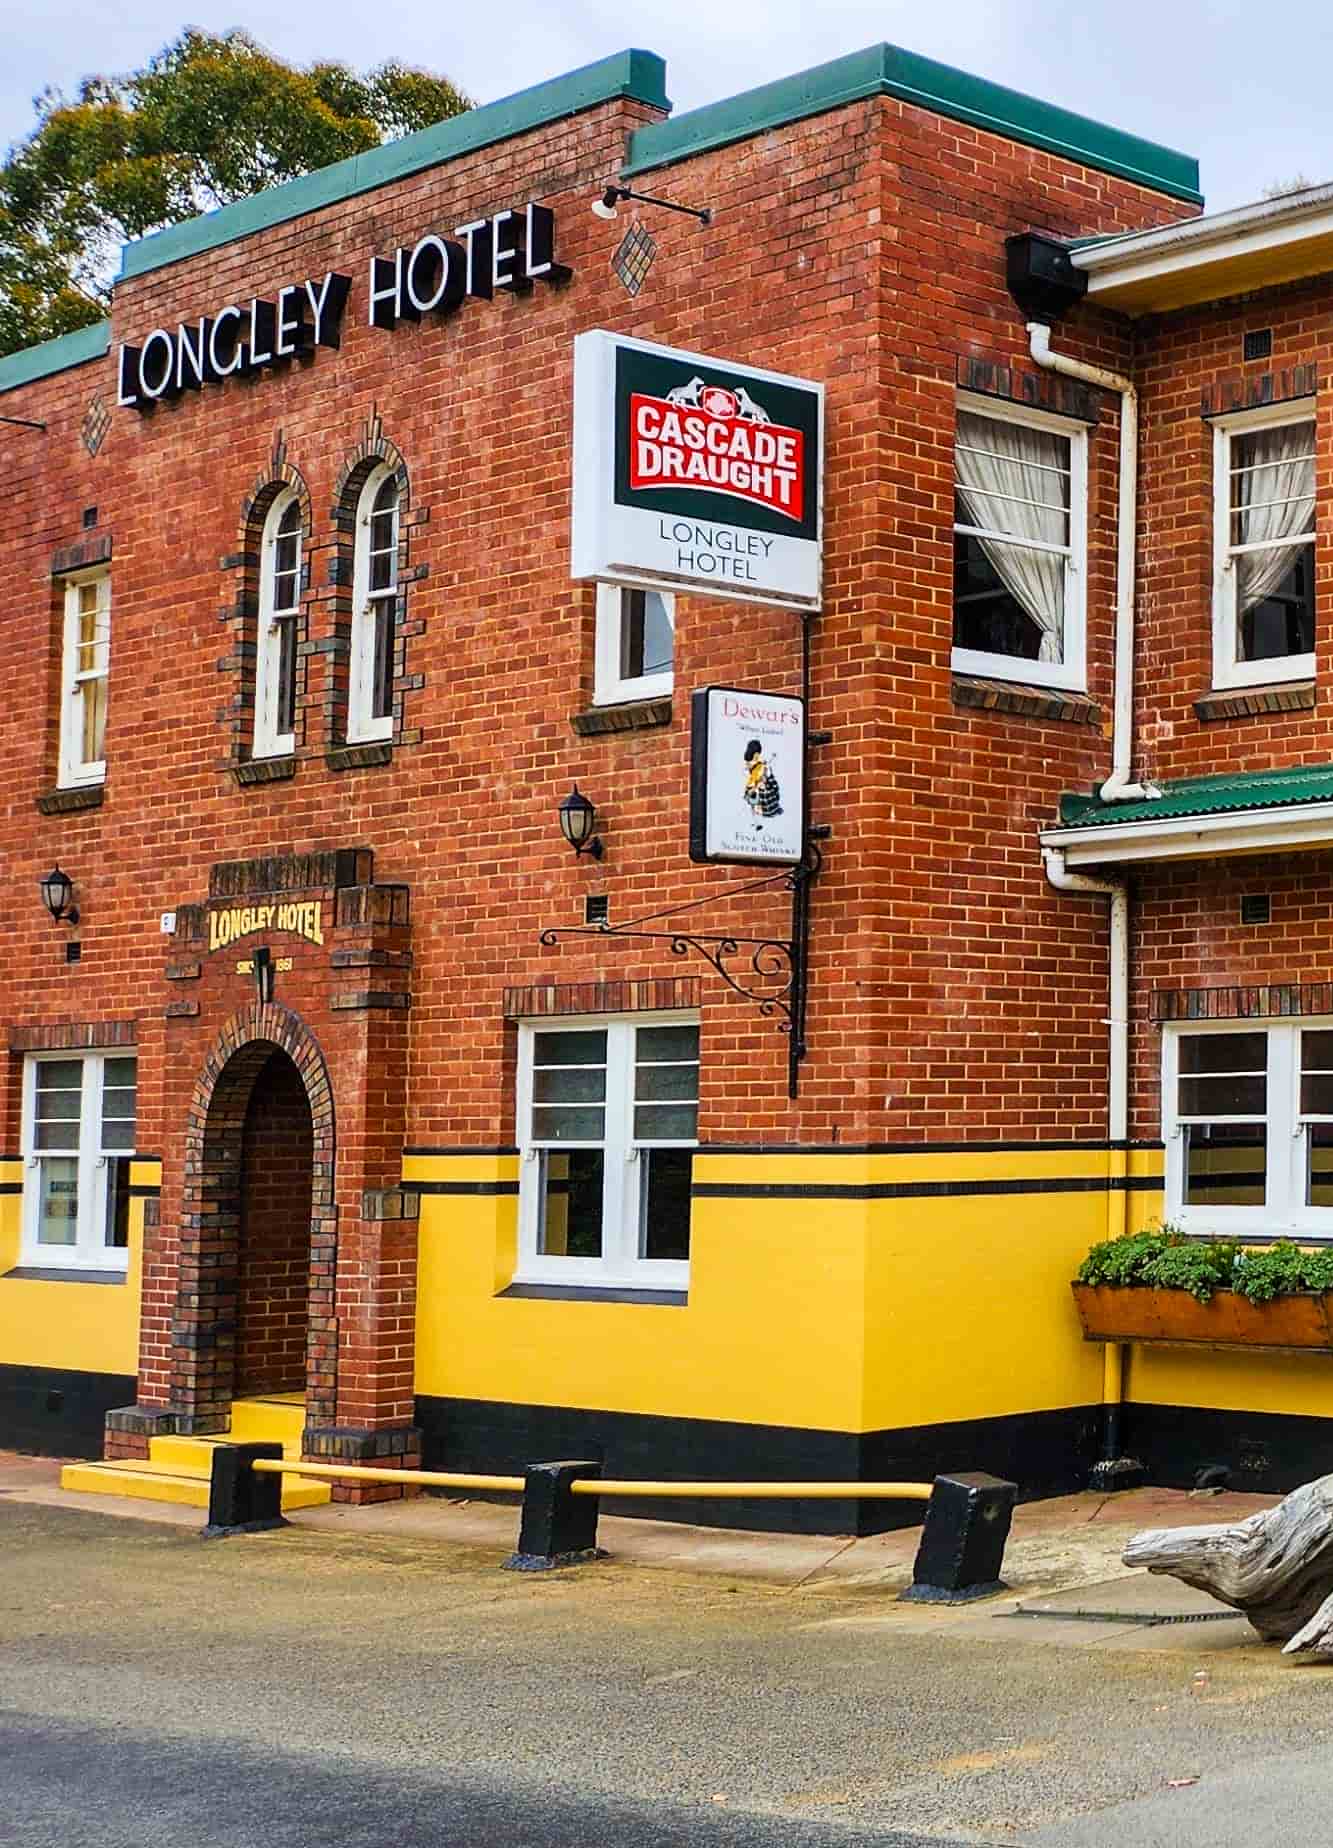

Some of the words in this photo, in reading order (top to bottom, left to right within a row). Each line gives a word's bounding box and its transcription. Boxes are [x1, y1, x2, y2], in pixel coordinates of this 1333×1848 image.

[118, 271, 342, 406] LONGLEY
[369, 202, 556, 328] HOTEL
[637, 405, 797, 469] CASCADE
[637, 439, 797, 505] DRAUGHT
[659, 519, 774, 557] LONGLEY
[678, 549, 757, 581] HOTEL
[723, 697, 801, 725] Dewar's
[209, 906, 275, 951] LONGLEY
[278, 901, 324, 945] HOTEL
[236, 960, 256, 975] SINC
